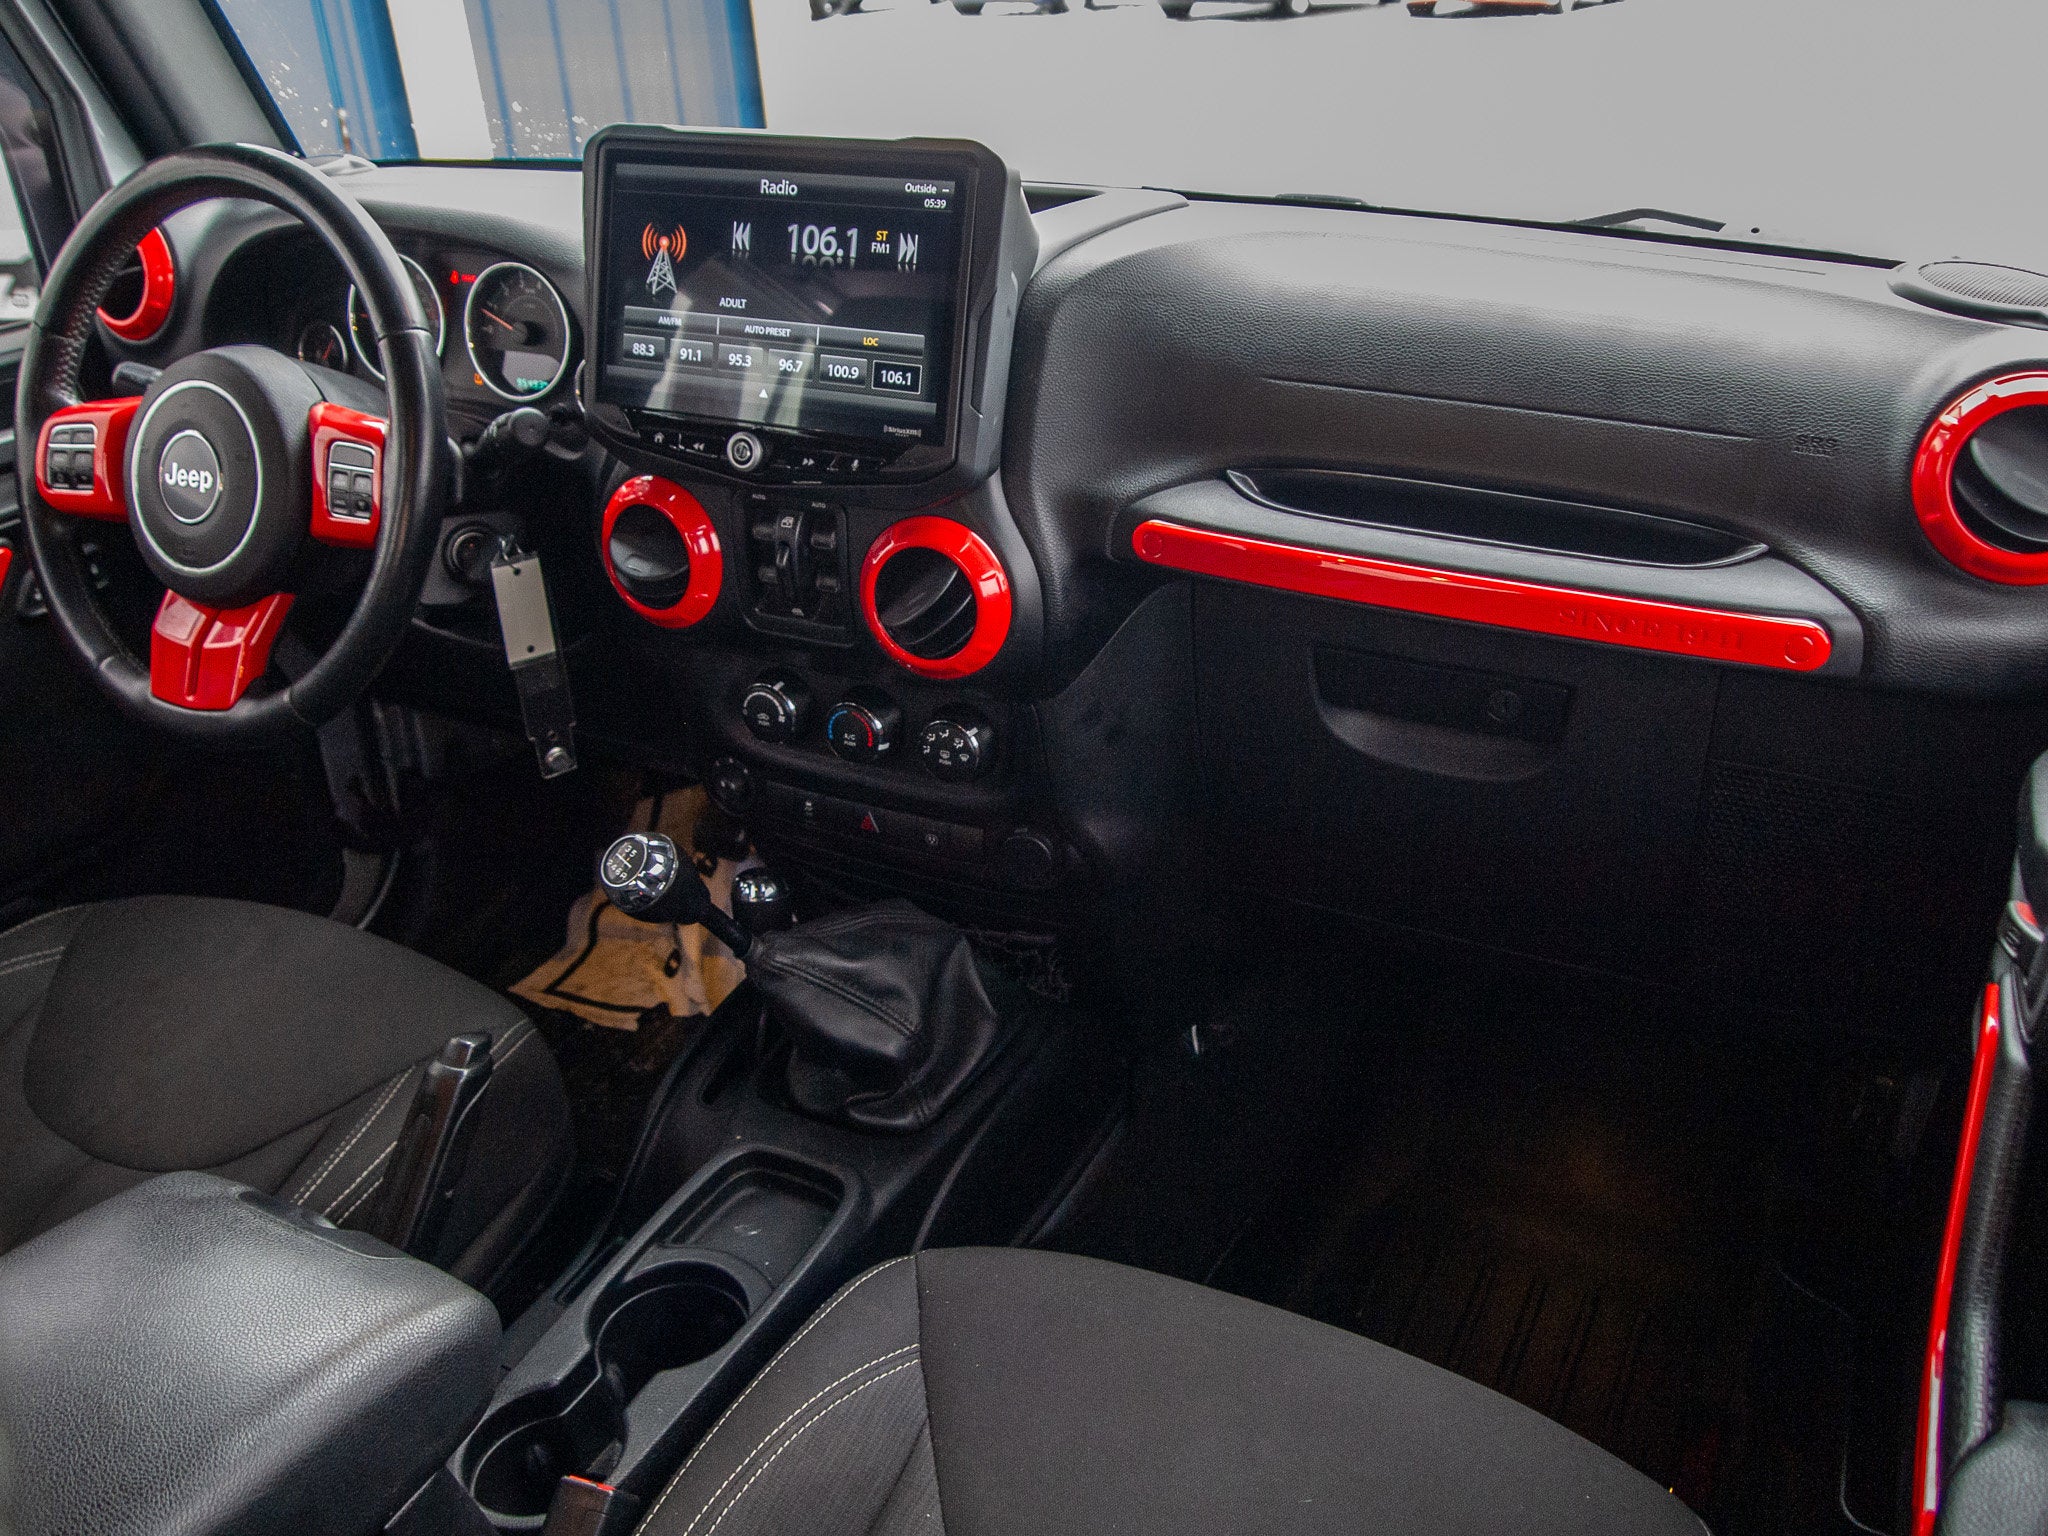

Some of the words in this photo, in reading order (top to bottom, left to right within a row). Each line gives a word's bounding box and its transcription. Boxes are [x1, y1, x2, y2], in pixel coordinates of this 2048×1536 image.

[761, 178, 798, 196] Radio
[904, 182, 937, 195] Outside
[924, 198, 947, 209] 05:39
[787, 223, 859, 257] 106.1
[876, 230, 888, 241] ST
[871, 242, 890, 254] FM1
[719, 297, 747, 309] ADULT
[658, 316, 682, 326] AM/FM
[744, 324, 764, 335] AUTO
[765, 327, 791, 338] PRESET
[863, 337, 879, 347] LOC
[632, 343, 656, 357] 88.3
[680, 348, 702, 362] 91.1
[728, 353, 752, 368] 95.3
[779, 359, 803, 373] 96.7
[827, 364, 860, 379] 100.9
[880, 370, 912, 386] 106.1
[164, 462, 213, 493] Jeep
